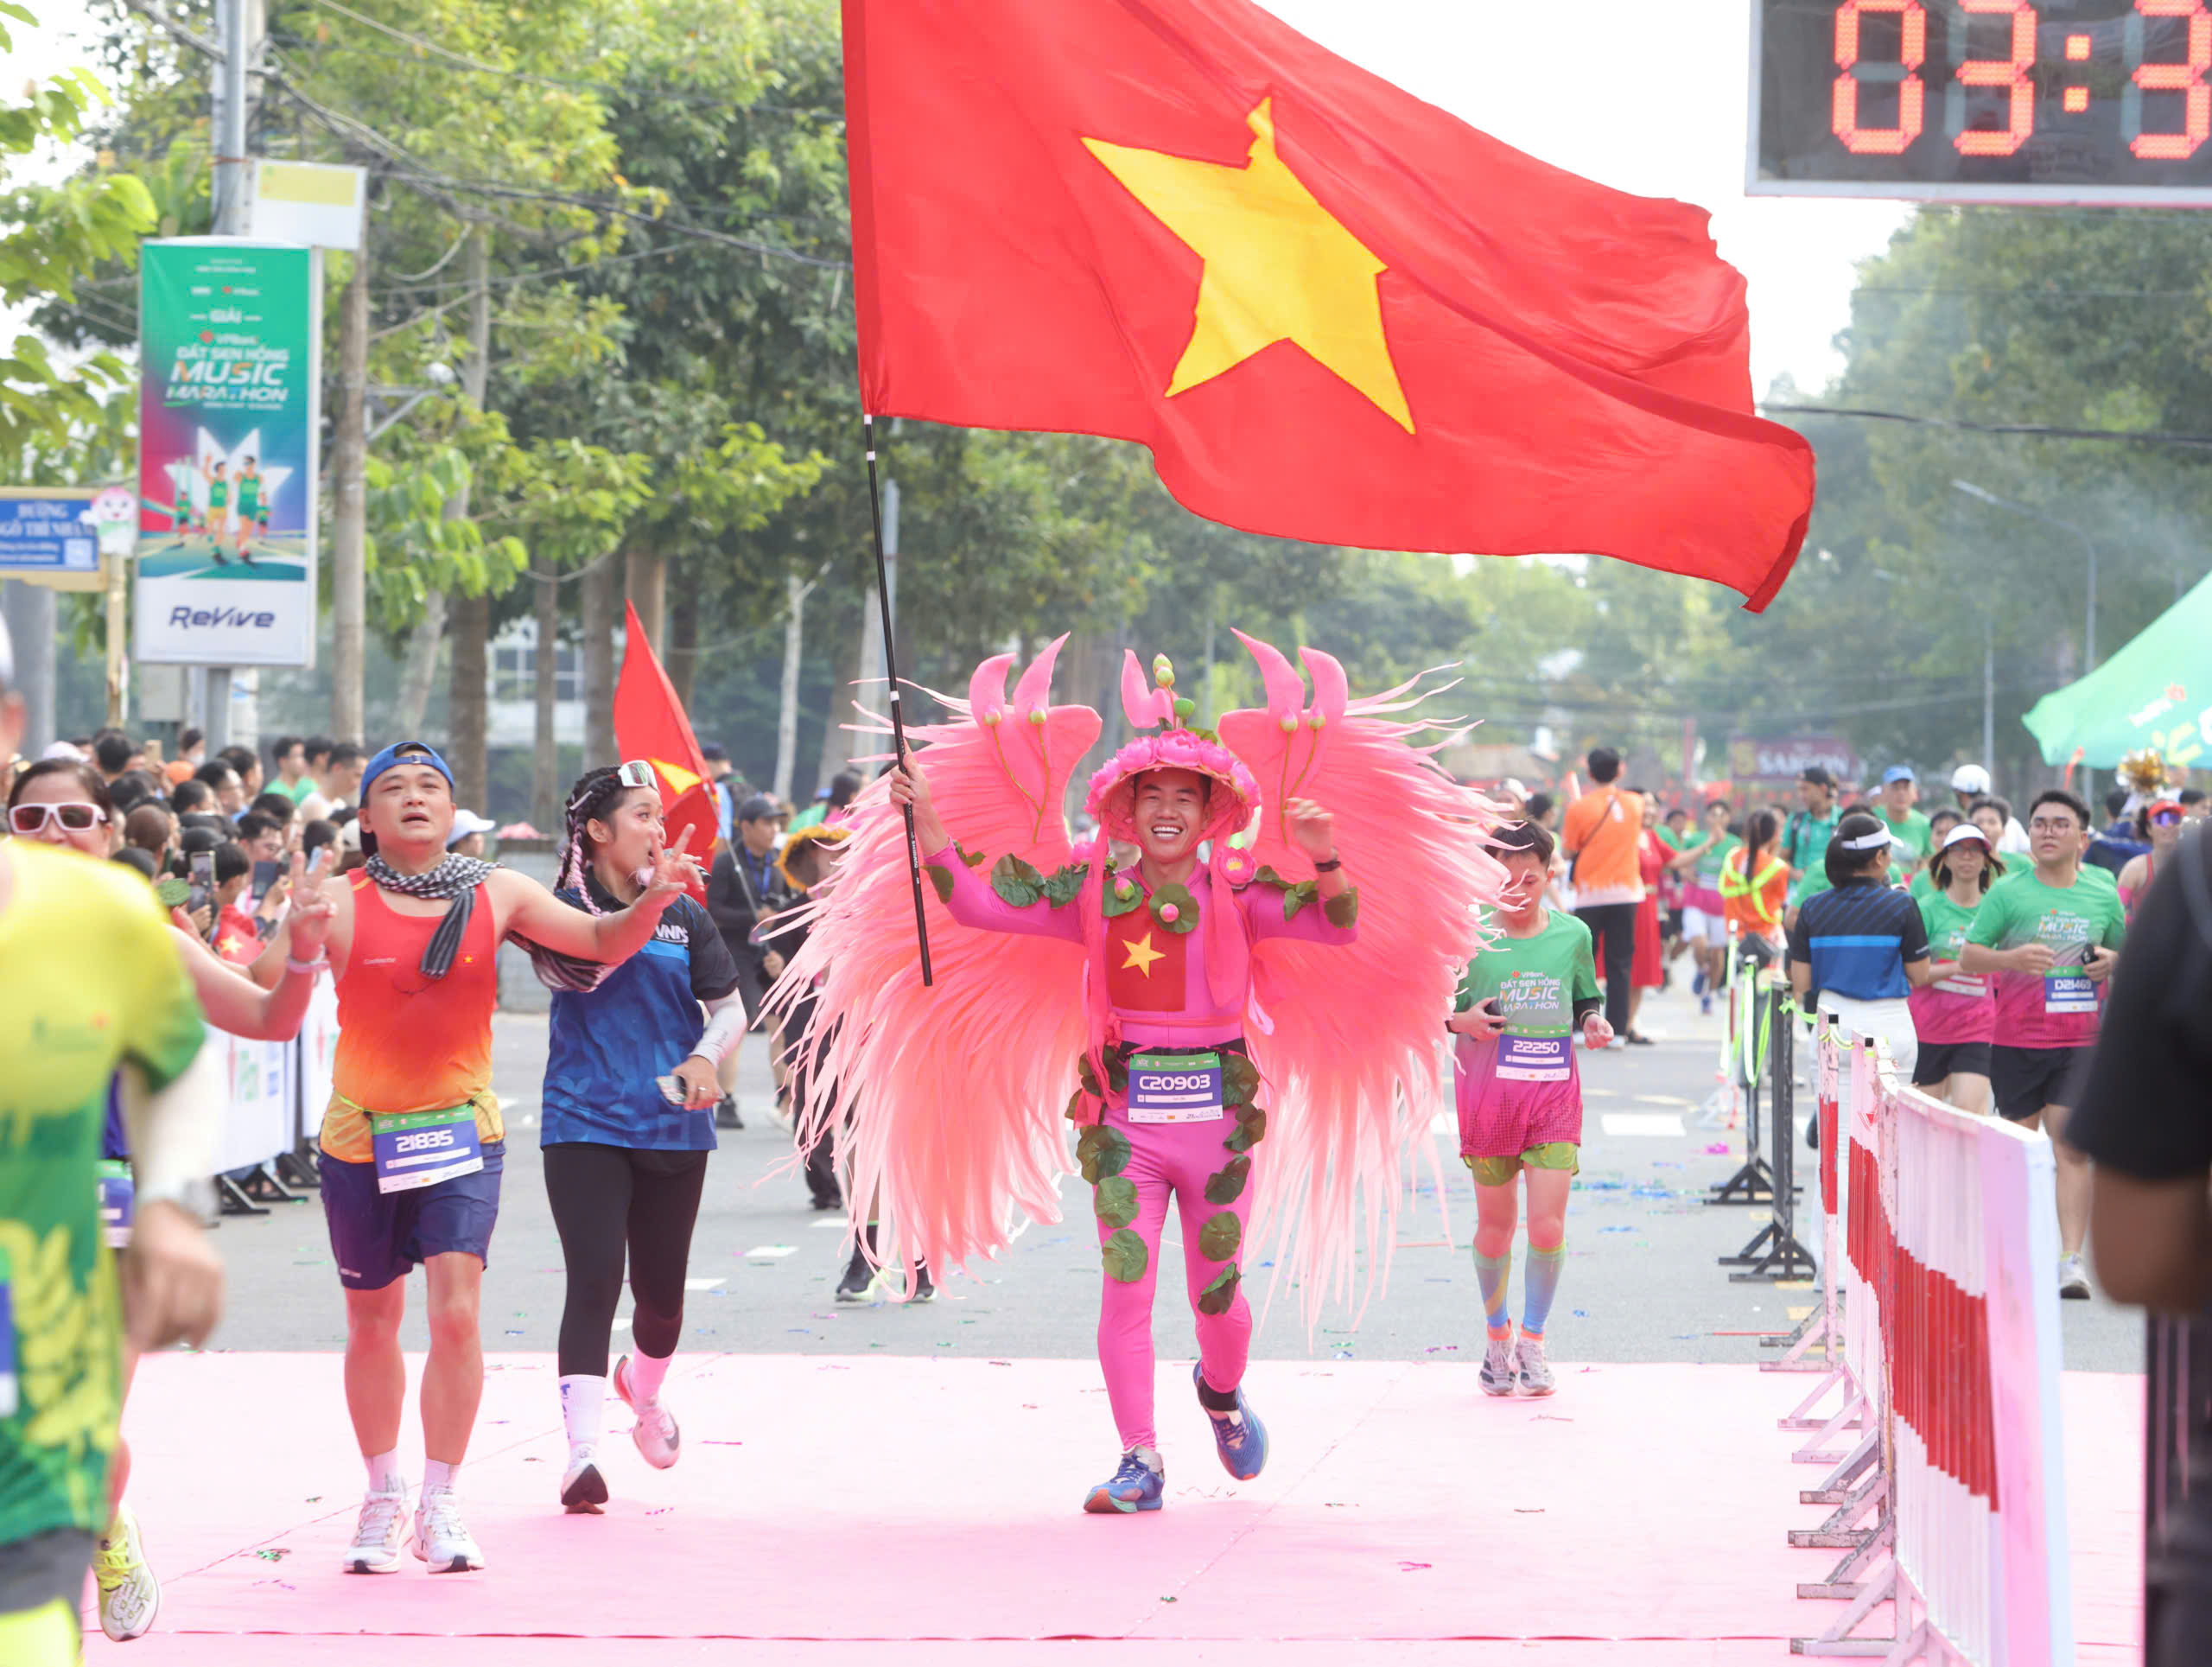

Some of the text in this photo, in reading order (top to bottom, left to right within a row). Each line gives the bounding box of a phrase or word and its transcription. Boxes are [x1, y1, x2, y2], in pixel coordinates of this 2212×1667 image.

[210, 347, 243, 360] SEN
[170, 361, 288, 385] MUSIC
[165, 385, 289, 401] MARATHON
[168, 606, 276, 628] ReVive
[2038, 921, 2088, 934] MUSIC
[1500, 980, 1517, 989] ĐẤT
[1499, 987, 1560, 1002] MUSIC
[1513, 1040, 1560, 1053] 22250
[1139, 1074, 1211, 1091] C20903
[395, 1129, 454, 1153] 21835
